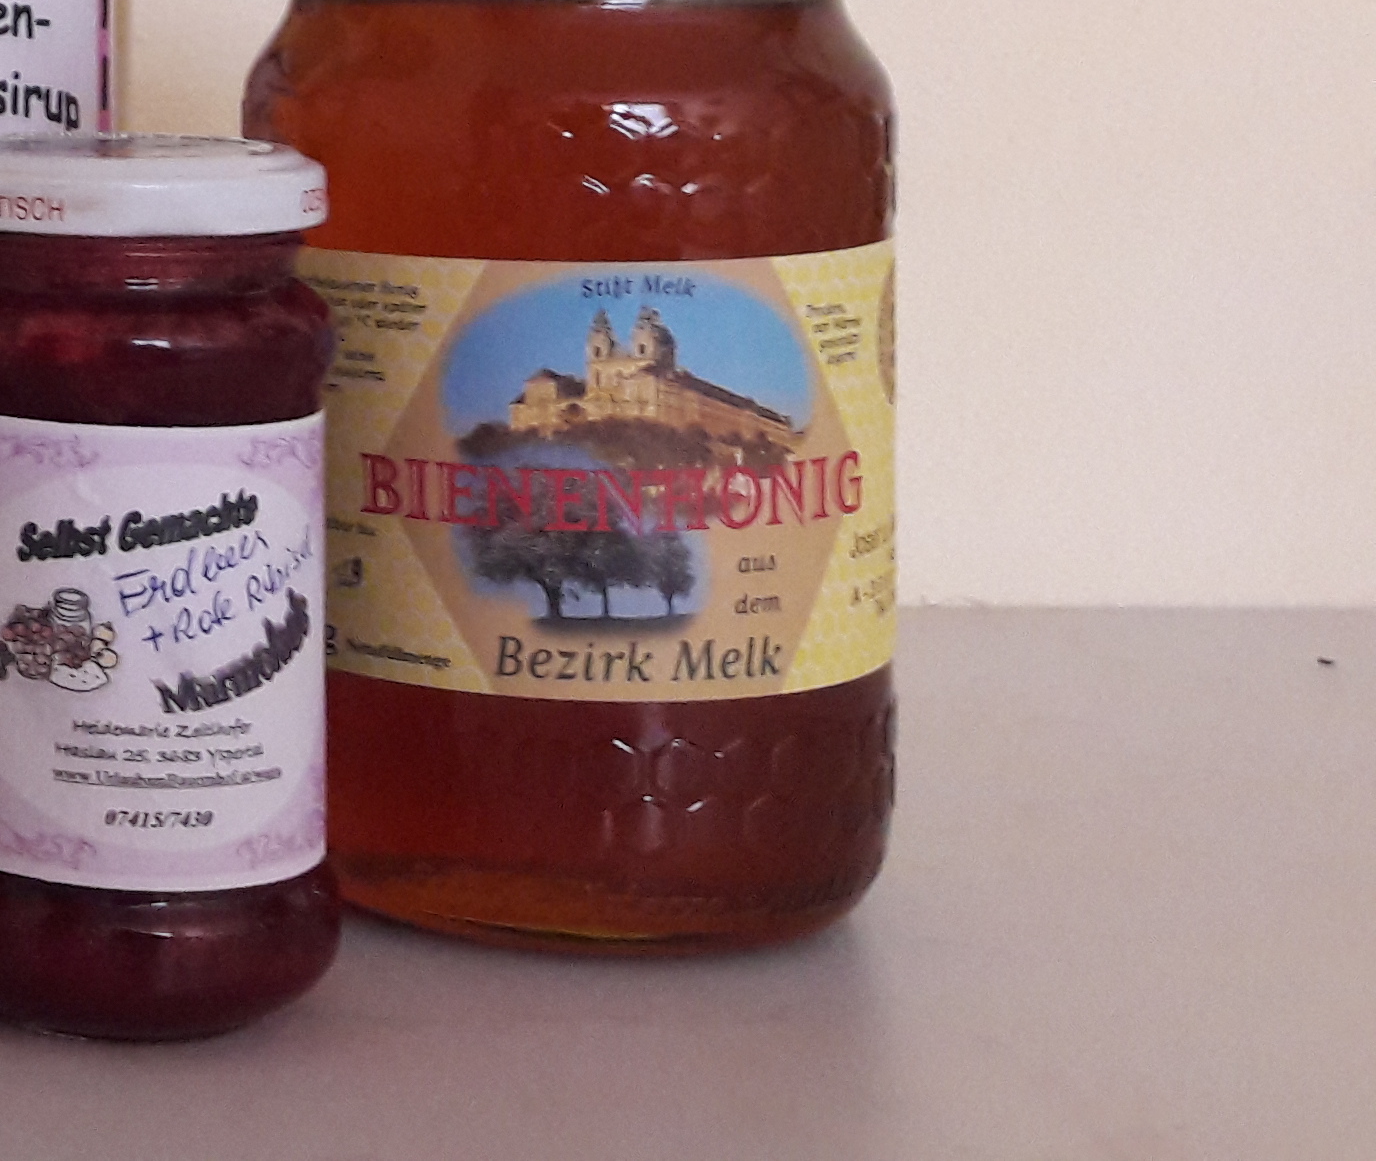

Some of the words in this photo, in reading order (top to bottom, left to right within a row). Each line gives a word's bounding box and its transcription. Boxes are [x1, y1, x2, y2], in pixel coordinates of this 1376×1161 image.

[581, 277, 634, 299] Stift
[642, 274, 696, 298] Melk
[359, 450, 865, 535] BIENENHONIG
[738, 555, 776, 573] aus
[735, 594, 781, 614] dem
[498, 636, 654, 682] Bezirk
[671, 635, 782, 682] Melk
